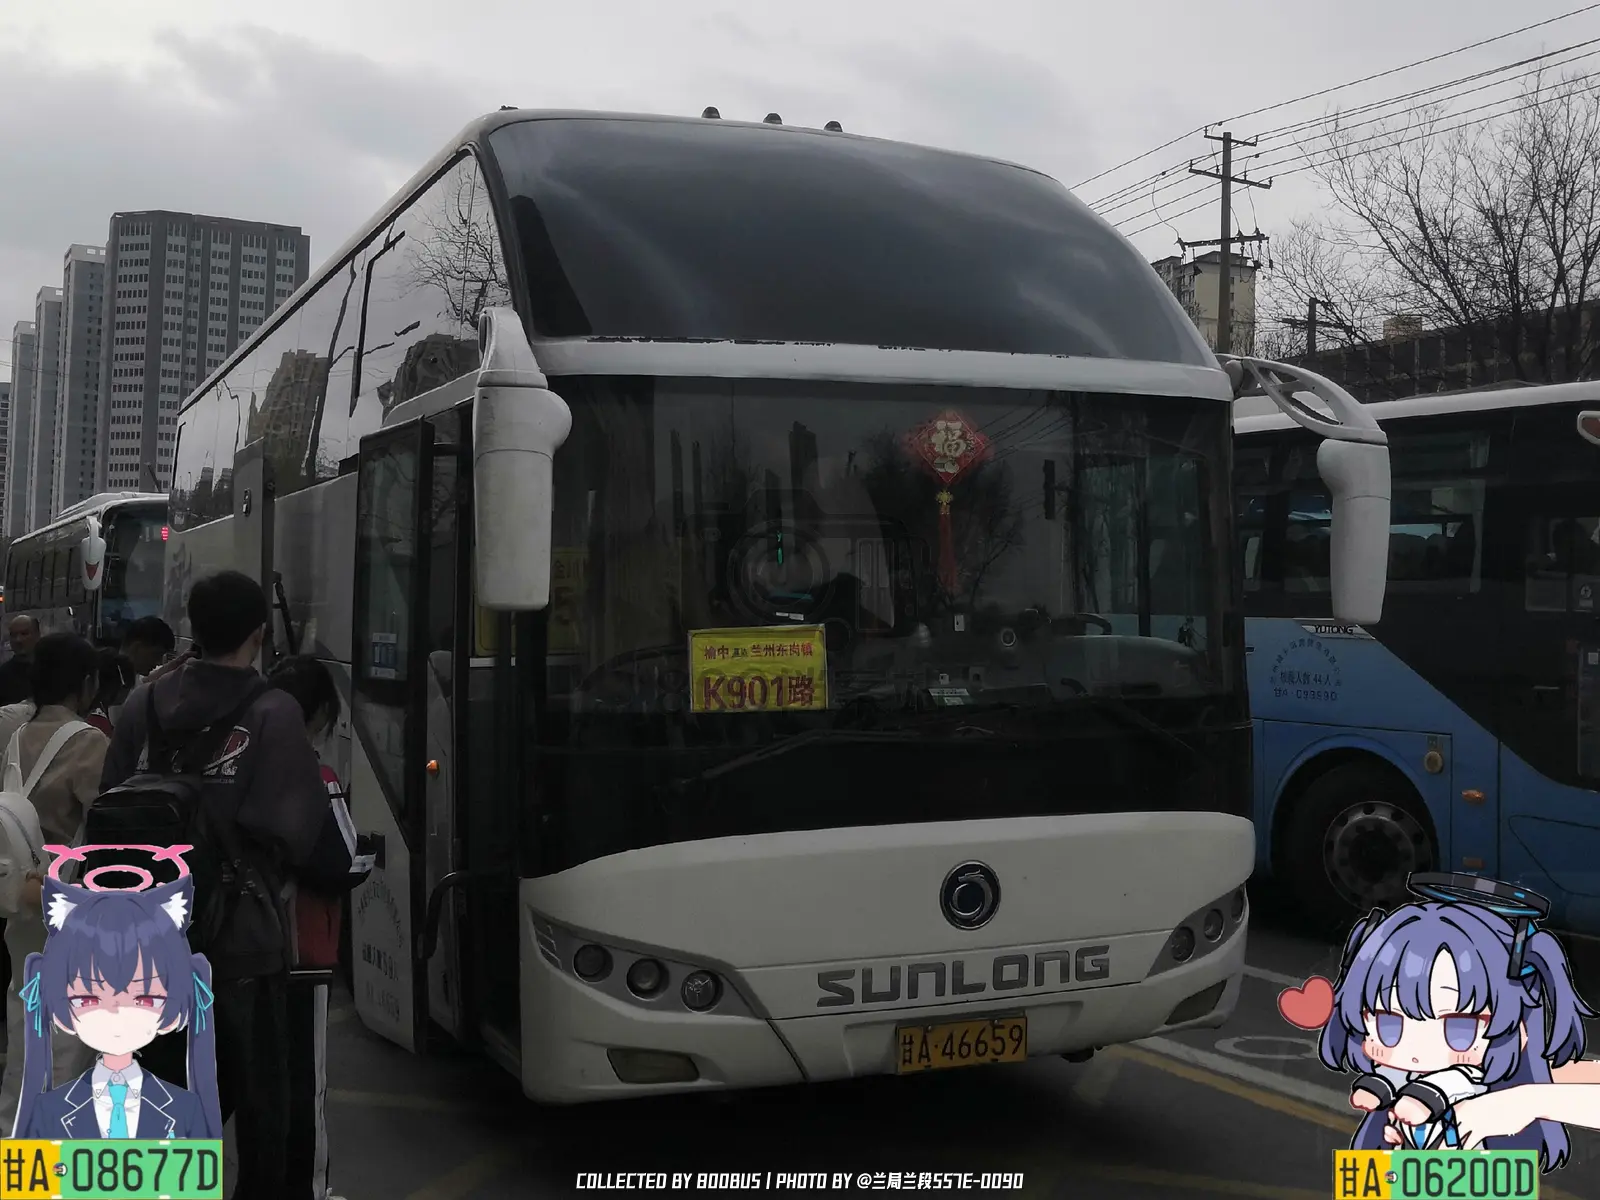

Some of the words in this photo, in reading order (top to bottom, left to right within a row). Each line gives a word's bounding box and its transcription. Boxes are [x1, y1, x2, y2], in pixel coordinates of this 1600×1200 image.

[1313, 625, 1354, 635] YUTONG
[704, 673, 815, 710] K901路
[816, 944, 1110, 1008] SUNLONG
